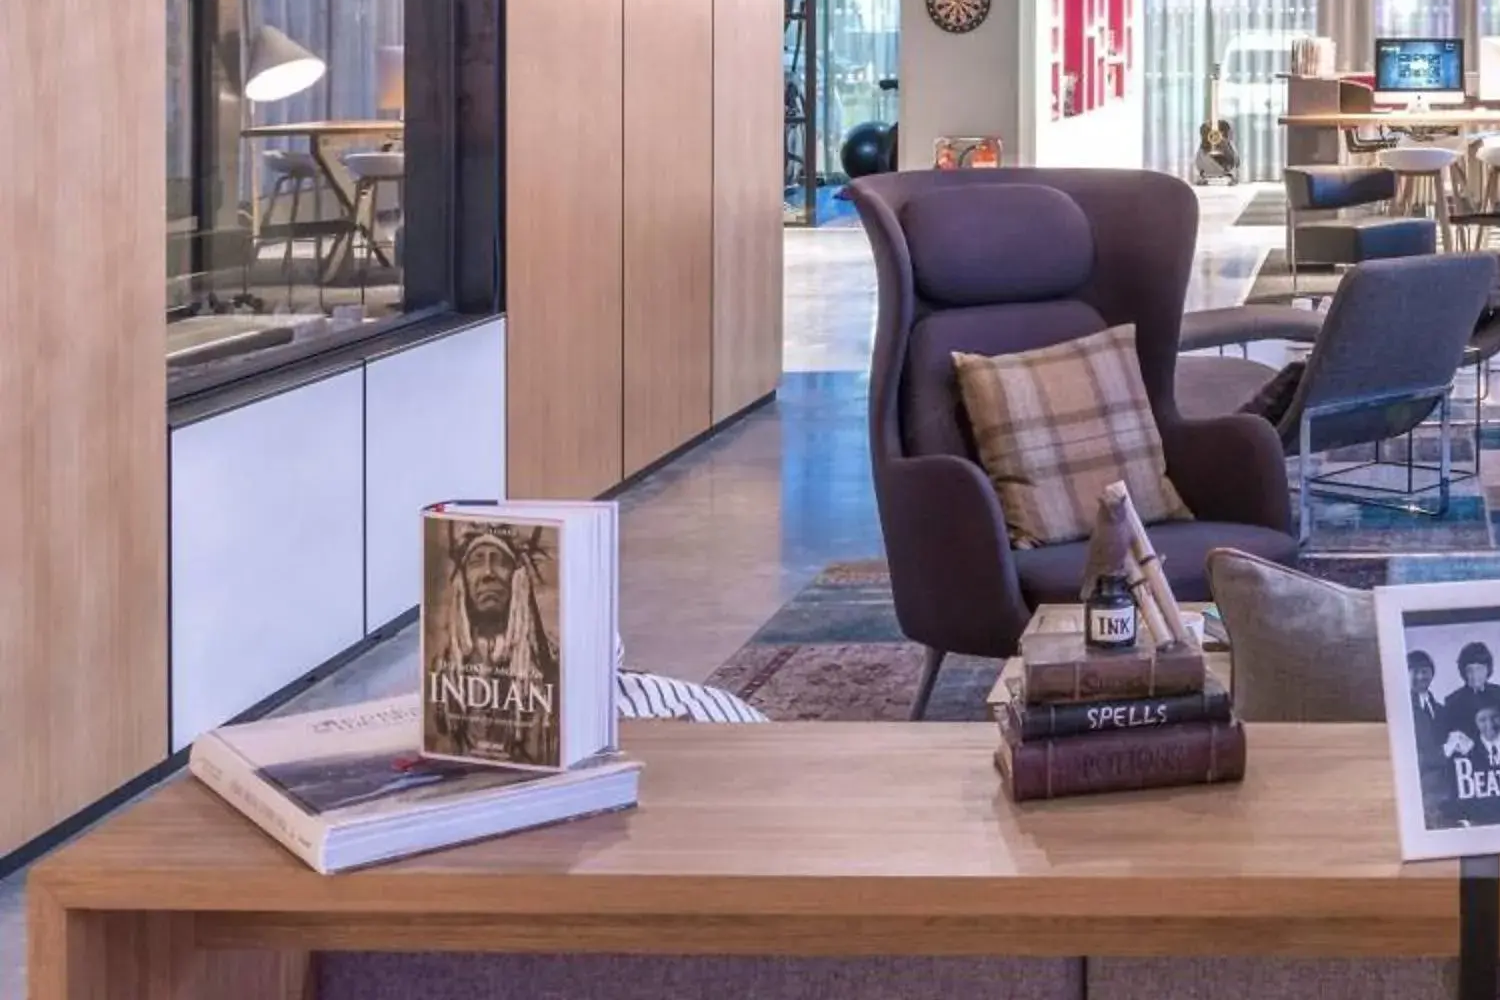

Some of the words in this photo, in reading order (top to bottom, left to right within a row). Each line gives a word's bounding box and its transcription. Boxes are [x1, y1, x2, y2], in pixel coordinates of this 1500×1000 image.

[1098, 616, 1130, 635] INK
[430, 671, 554, 714] INDIAN
[1087, 703, 1168, 729] SPELLS
